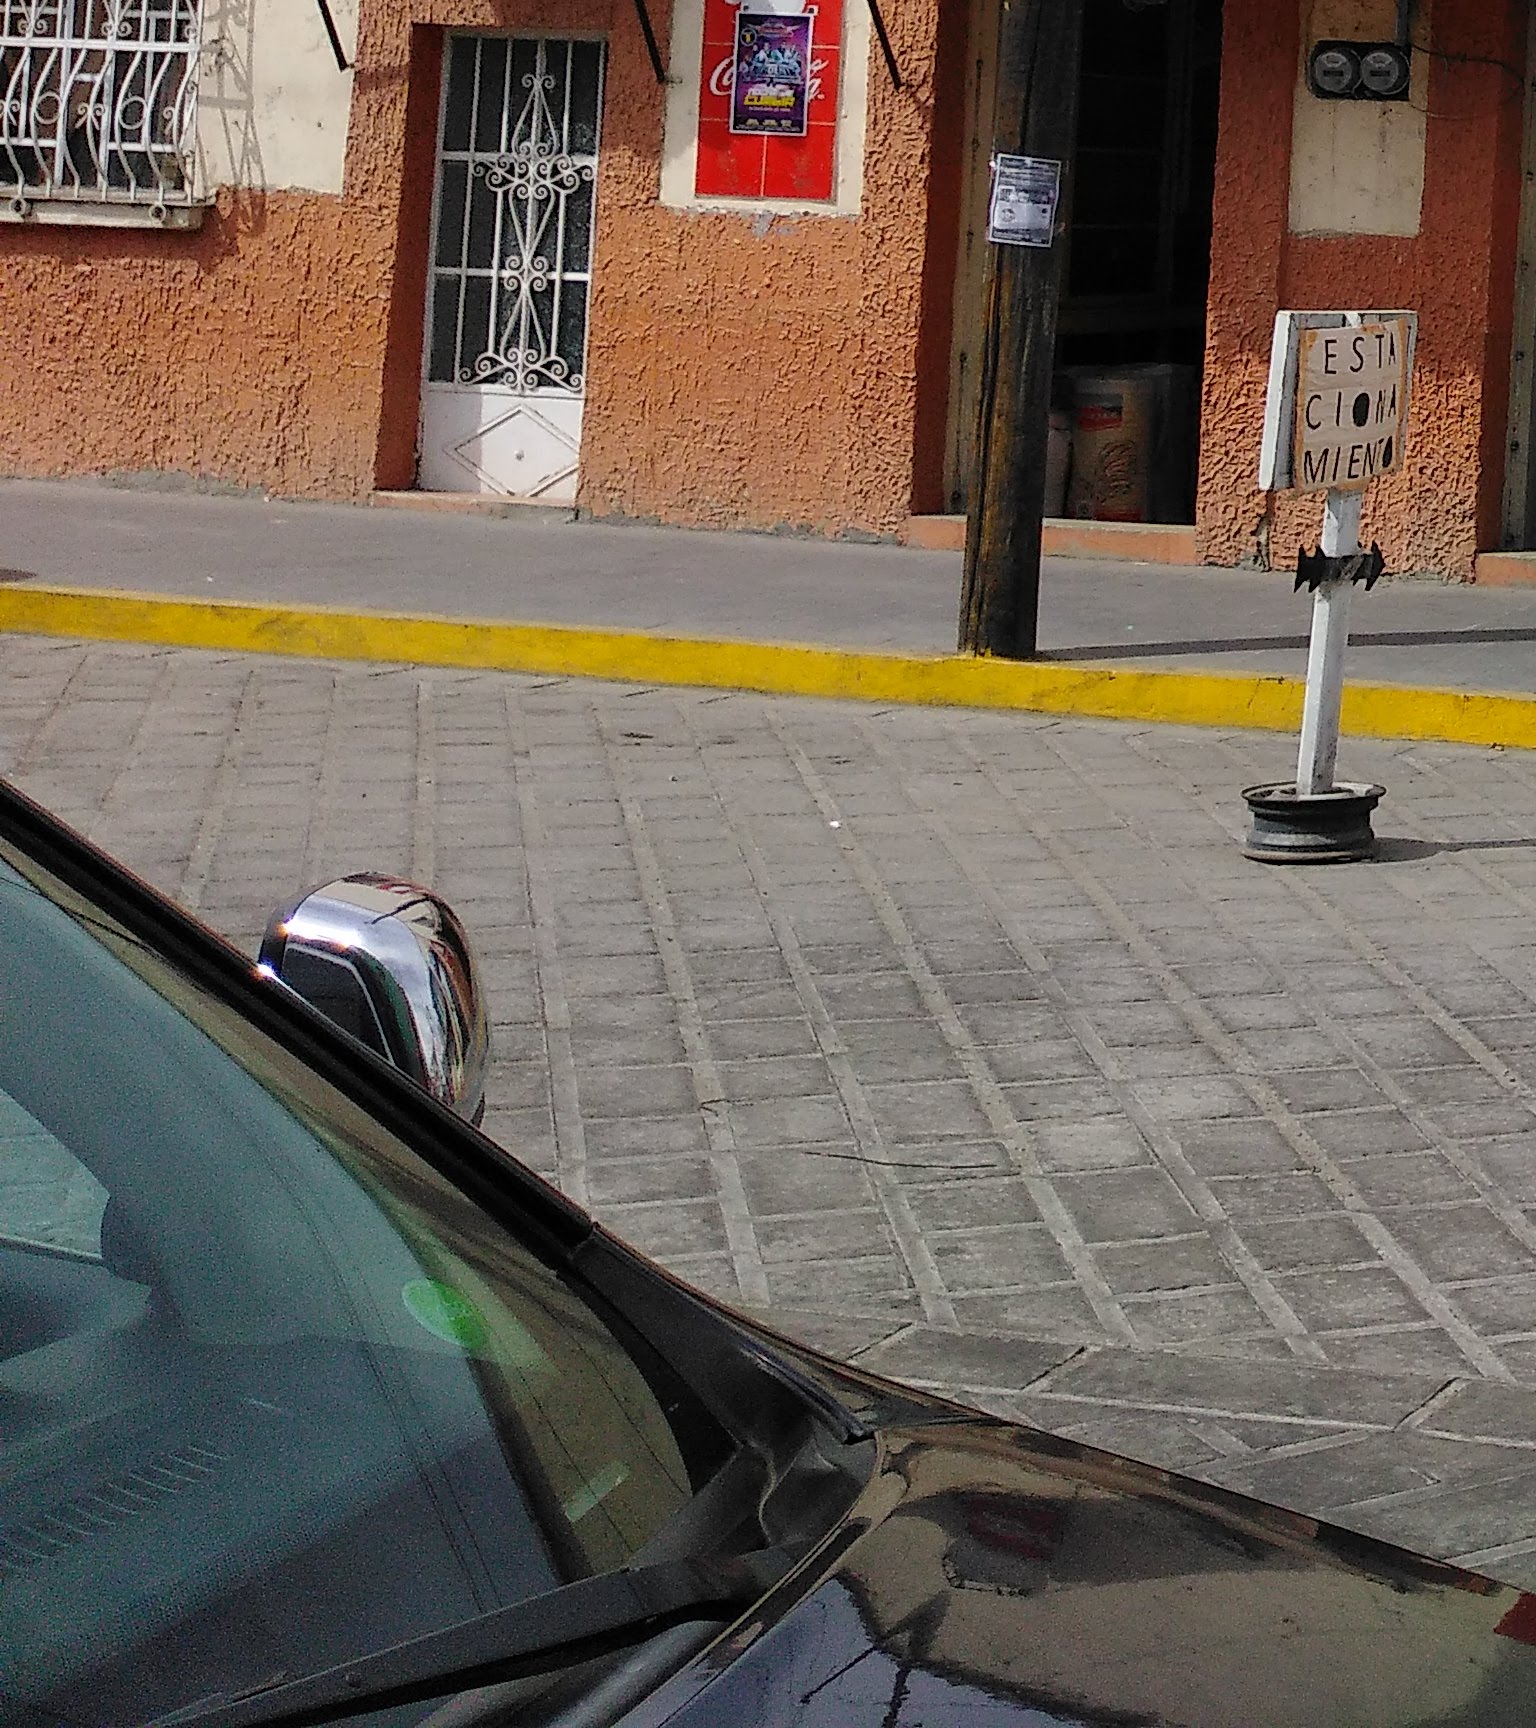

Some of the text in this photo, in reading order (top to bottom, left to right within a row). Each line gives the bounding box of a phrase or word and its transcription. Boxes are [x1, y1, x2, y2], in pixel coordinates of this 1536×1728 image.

[1324, 332, 1396, 375] ESTA
[1305, 384, 1398, 430] CIONA
[1303, 435, 1393, 484] MIENTO
